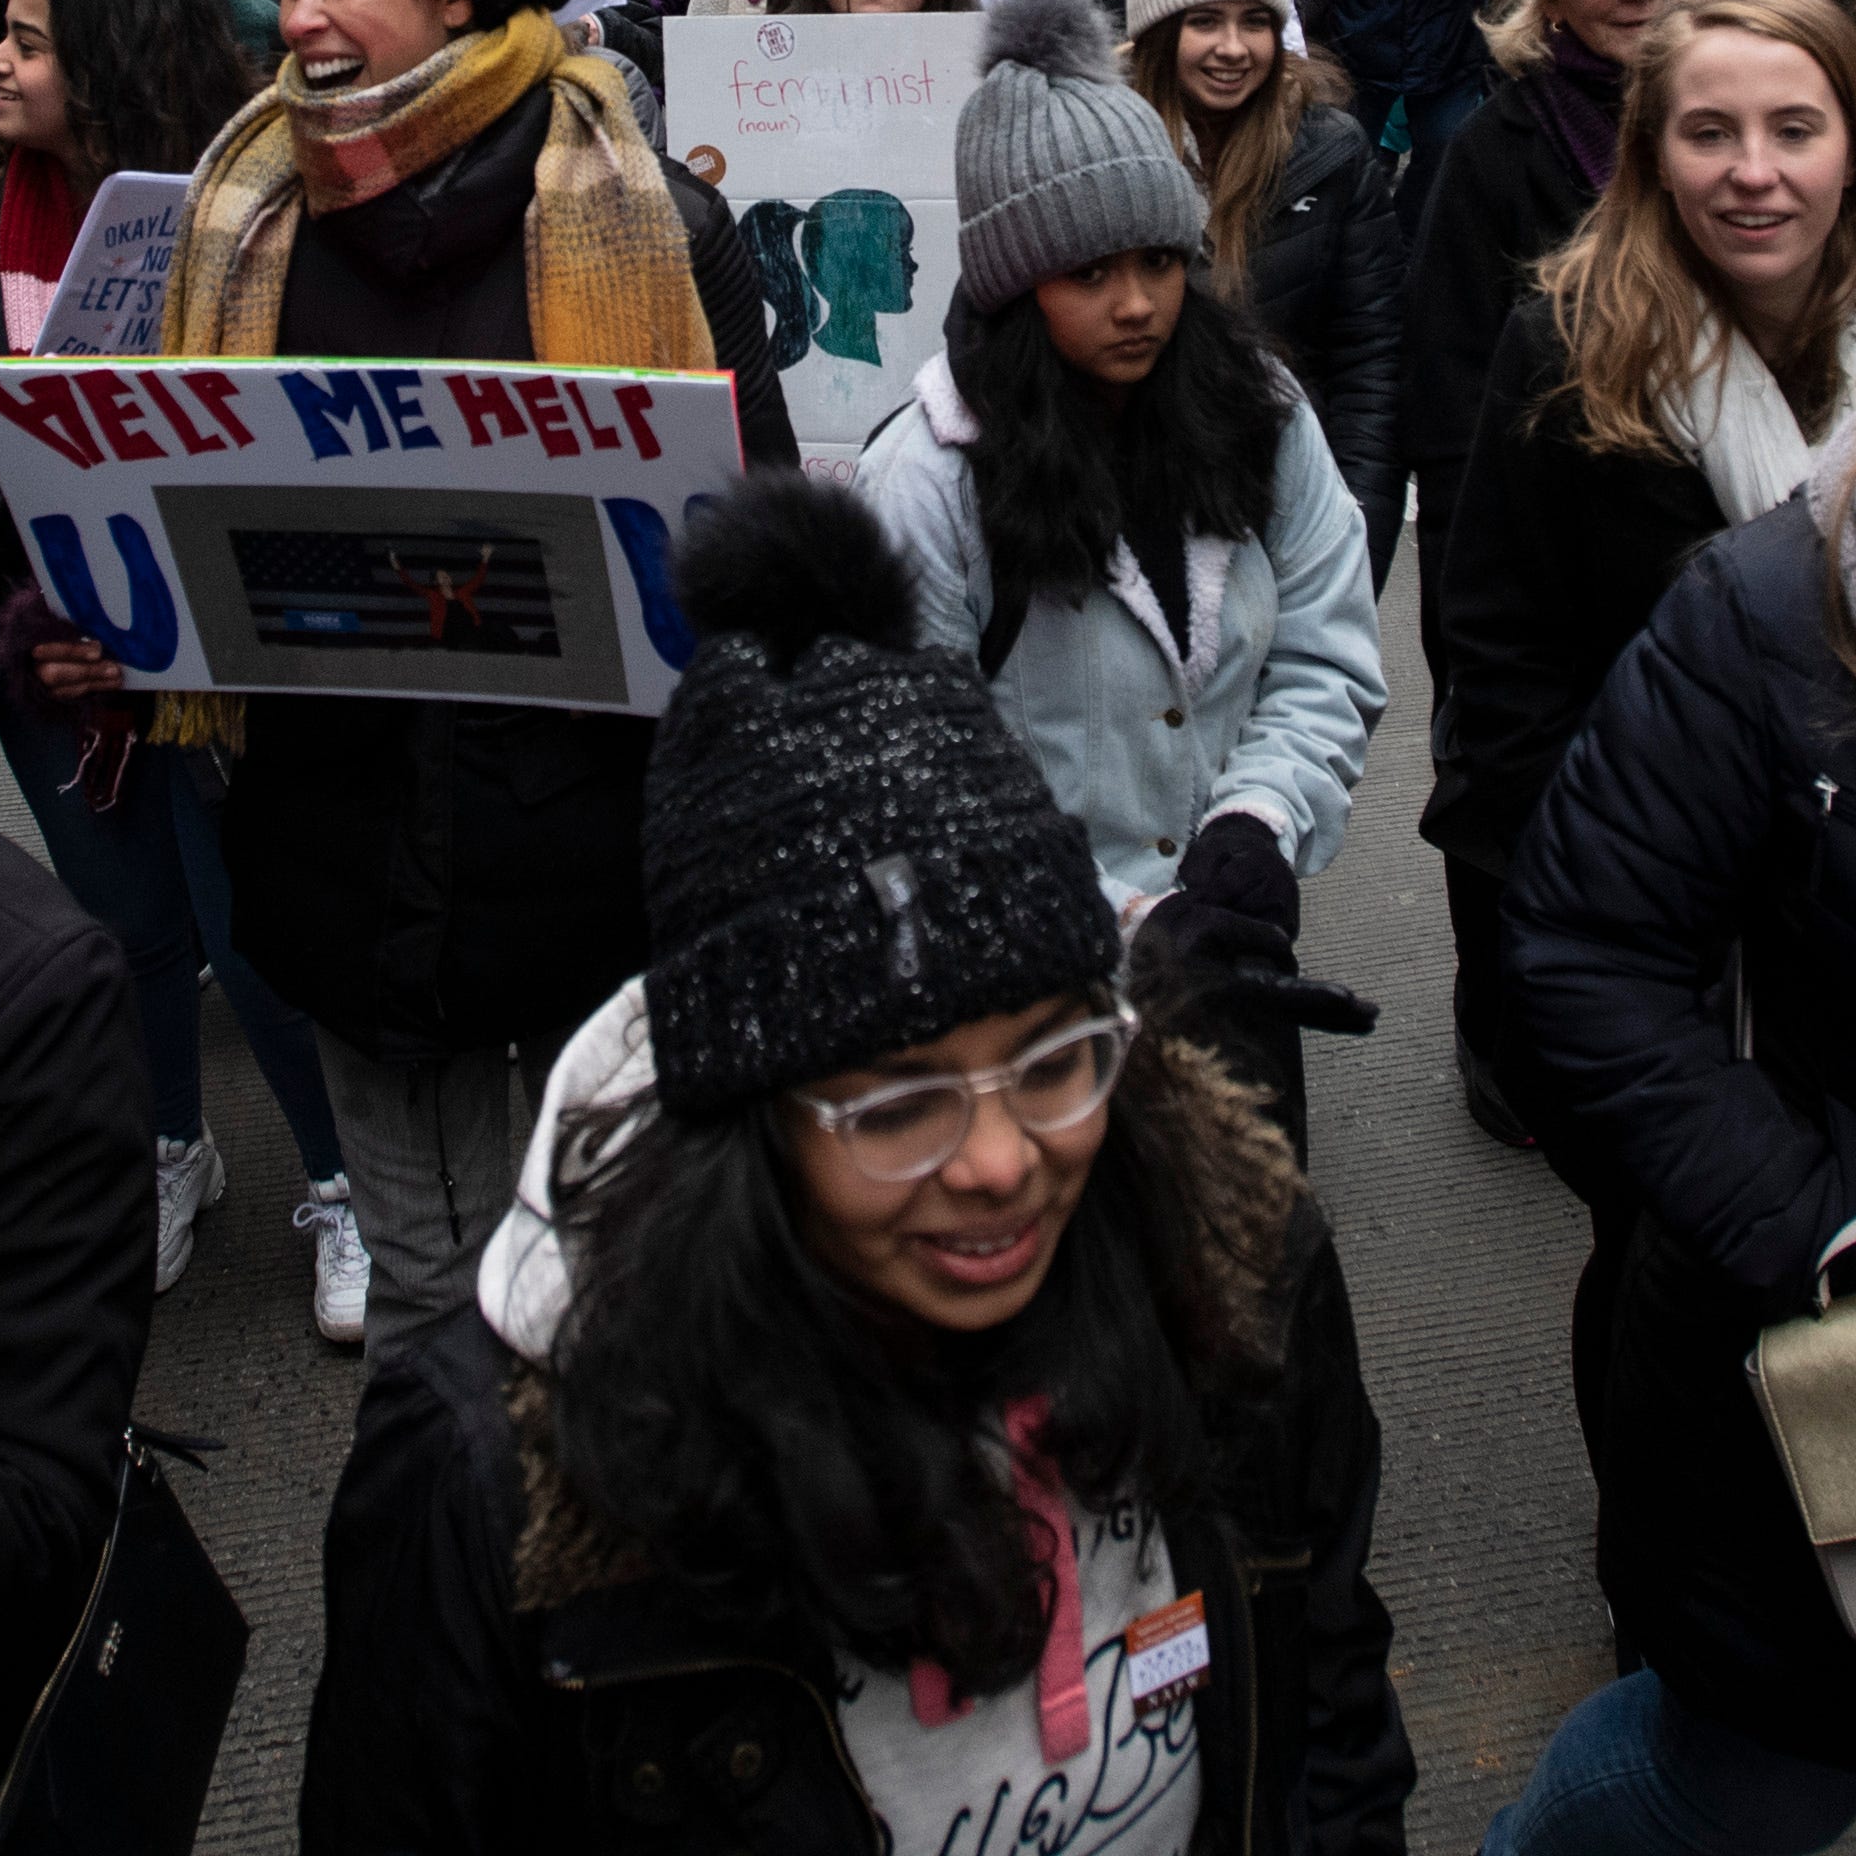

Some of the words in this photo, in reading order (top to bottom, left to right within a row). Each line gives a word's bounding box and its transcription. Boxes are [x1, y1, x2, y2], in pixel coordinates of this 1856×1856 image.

[737, 113, 801, 136] (noun)
[103, 214, 160, 250] OKAY
[78, 276, 162, 314] LET'S
[117, 316, 156, 347] IN
[276, 368, 444, 462] ME
[442, 373, 664, 463] HELP
[29, 511, 180, 673] U
